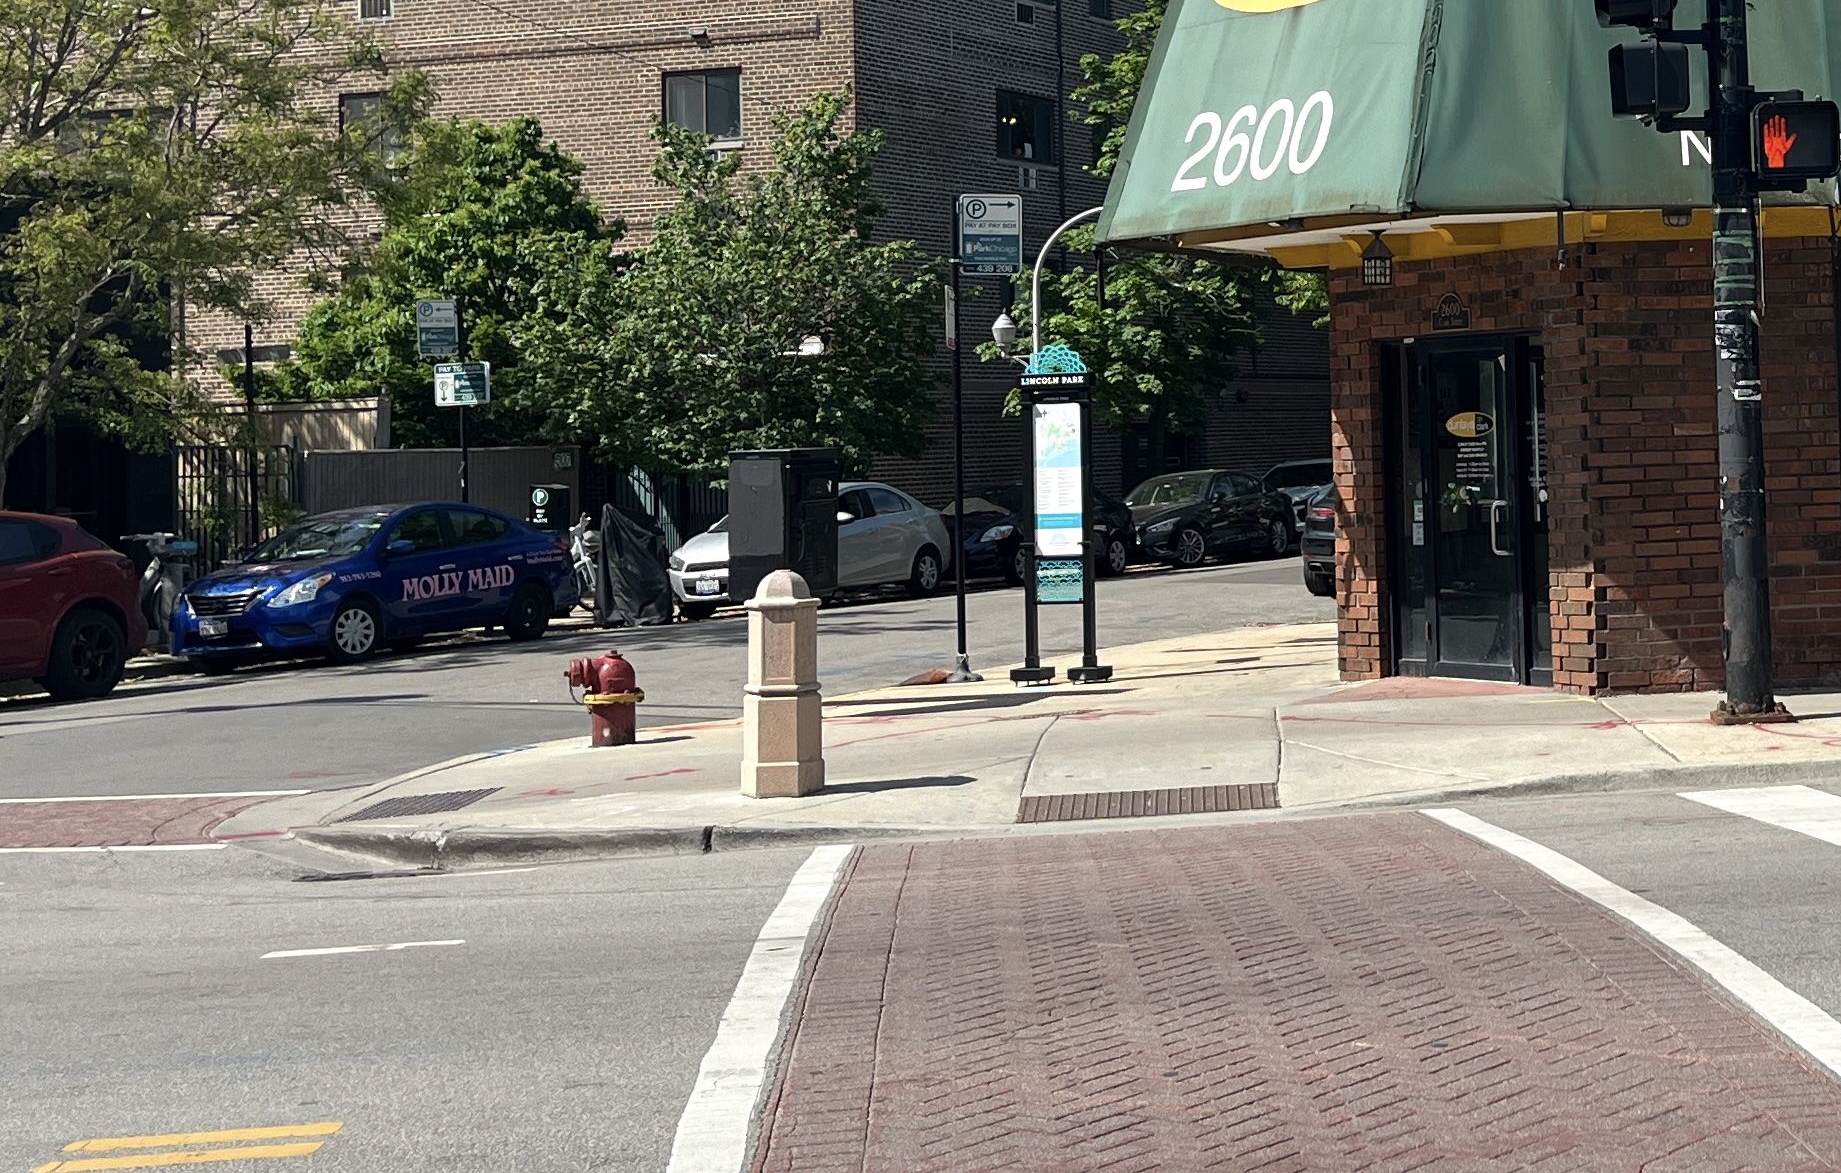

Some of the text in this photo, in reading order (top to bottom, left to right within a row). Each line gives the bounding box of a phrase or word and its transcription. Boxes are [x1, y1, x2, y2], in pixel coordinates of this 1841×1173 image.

[1171, 90, 1334, 193] 2600
[1021, 375, 1084, 385] LINCOLN PARK
[402, 564, 515, 602] MOLLY MAID
